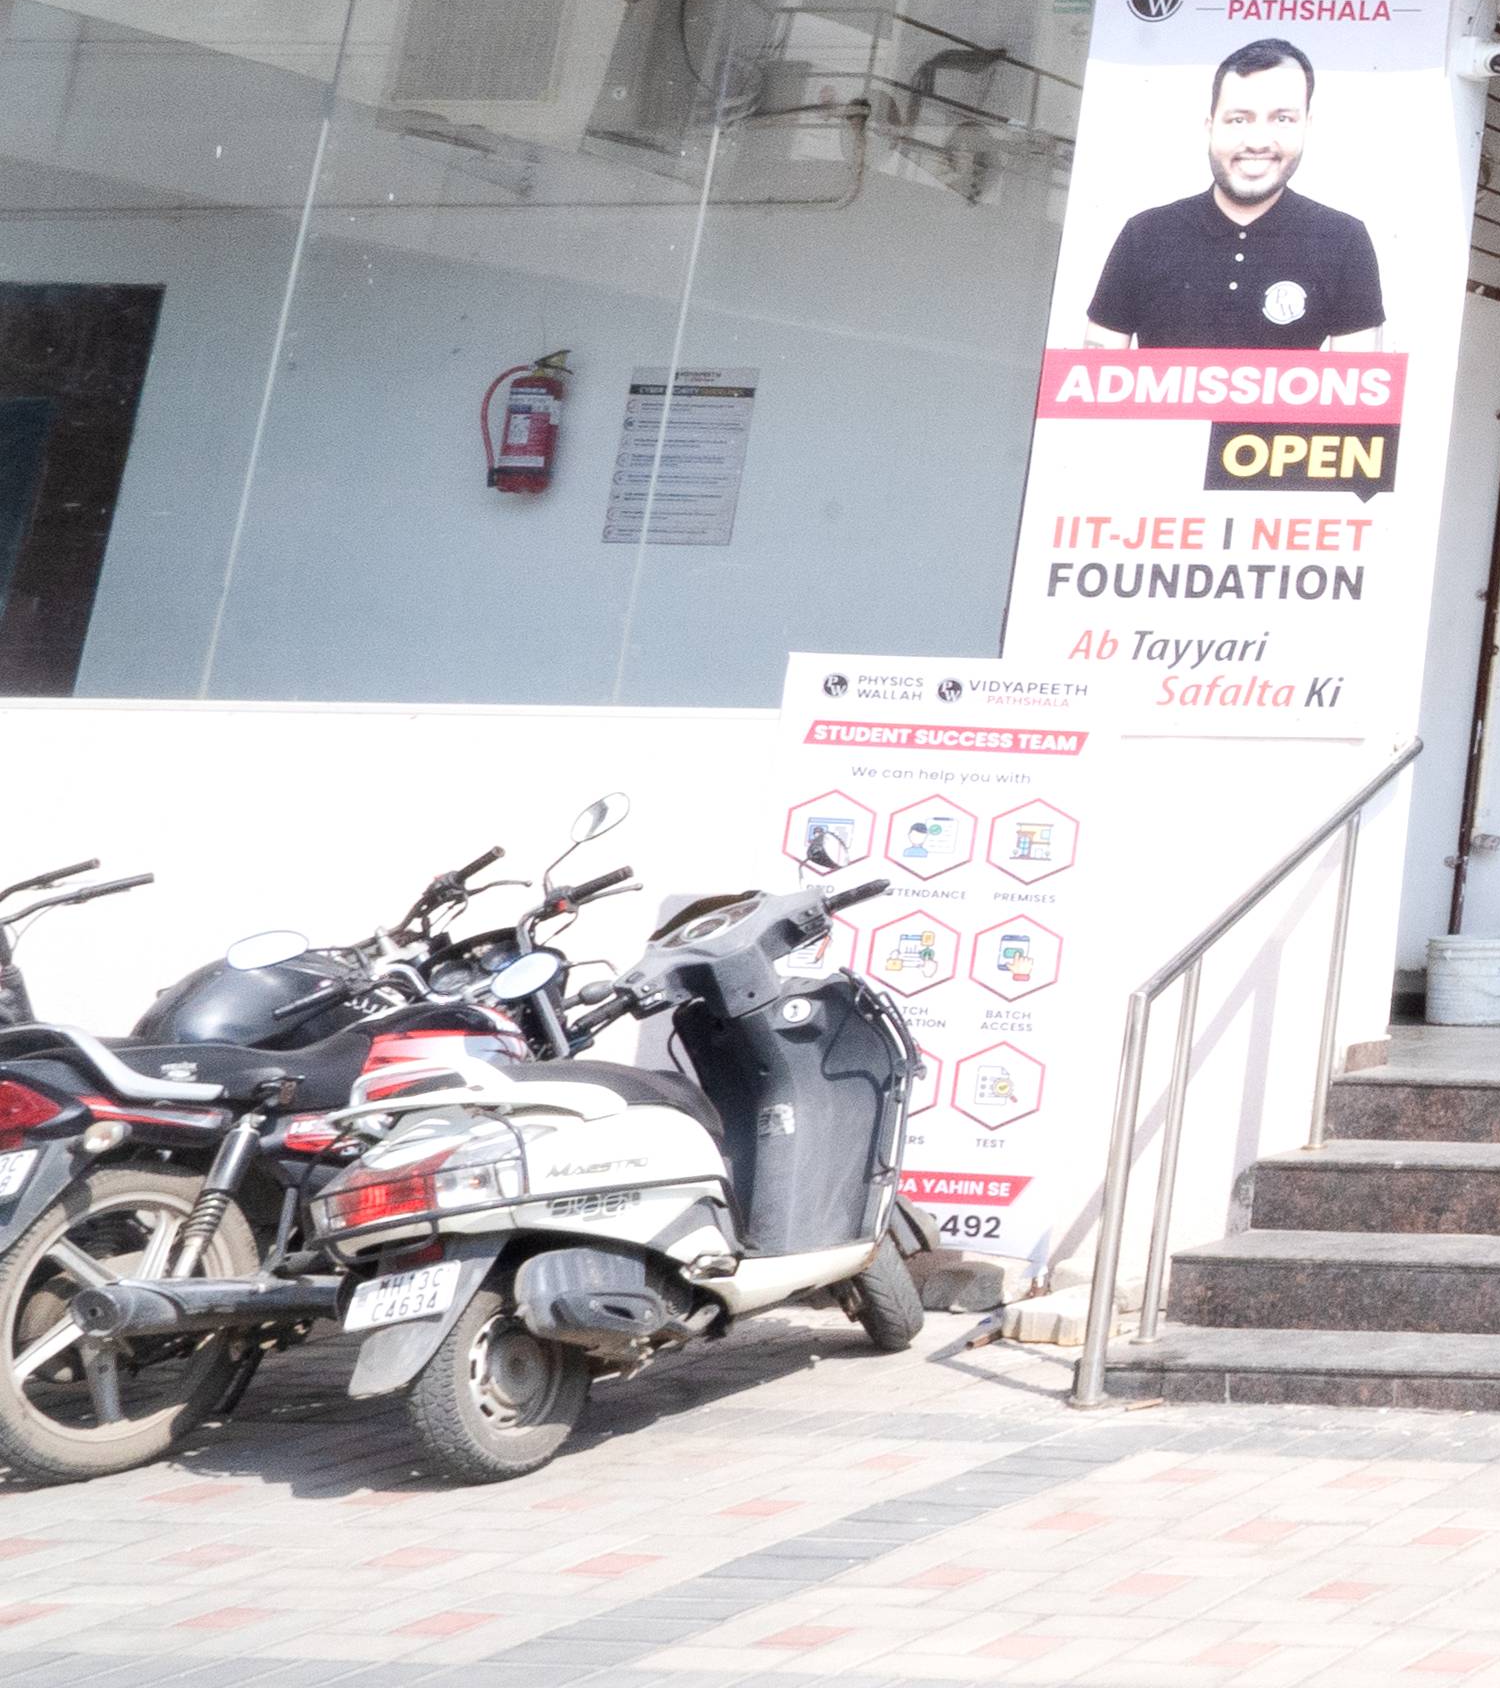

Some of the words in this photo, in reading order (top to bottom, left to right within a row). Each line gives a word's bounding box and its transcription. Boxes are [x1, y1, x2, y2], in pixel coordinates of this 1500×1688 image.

[1054, 363, 1393, 407] ADMISSIONS
[1221, 432, 1386, 479] OPEN
[1053, 516, 1207, 550] IIT-JEE
[1251, 517, 1374, 552] NEET
[1046, 561, 1366, 601] FOUNDATION
[1067, 628, 1120, 661] Ab
[1130, 629, 1271, 670] Tayyari
[857, 674, 925, 688] PHYSICS
[969, 679, 1089, 697] VIDYAPEETH
[1155, 673, 1297, 708] Safalta
[1303, 675, 1345, 709] Ki
[857, 688, 923, 701] WALLAH
[986, 694, 1070, 708] PATHSHALA
[813, 723, 913, 745] STUDENT
[914, 729, 1014, 749] SUCCESS
[1017, 733, 1078, 752] TEAM
[850, 766, 878, 778] We
[882, 768, 913, 780] can
[918, 768, 955, 784] help
[960, 771, 992, 785] you
[995, 771, 1031, 785] with
[890, 886, 967, 901] TTENDANCE
[993, 891, 1056, 904] PREMISES
[984, 1009, 1031, 1021] BATCH
[980, 1021, 1033, 1033] ACCESS
[974, 1137, 1006, 1149] TEST
[921, 1178, 984, 1197] YAHIN
[986, 1182, 1012, 1198] SE
[929, 1213, 1002, 1240] 492
[376, 1268, 444, 1300] MH13C
[371, 1291, 438, 1323] C4634
